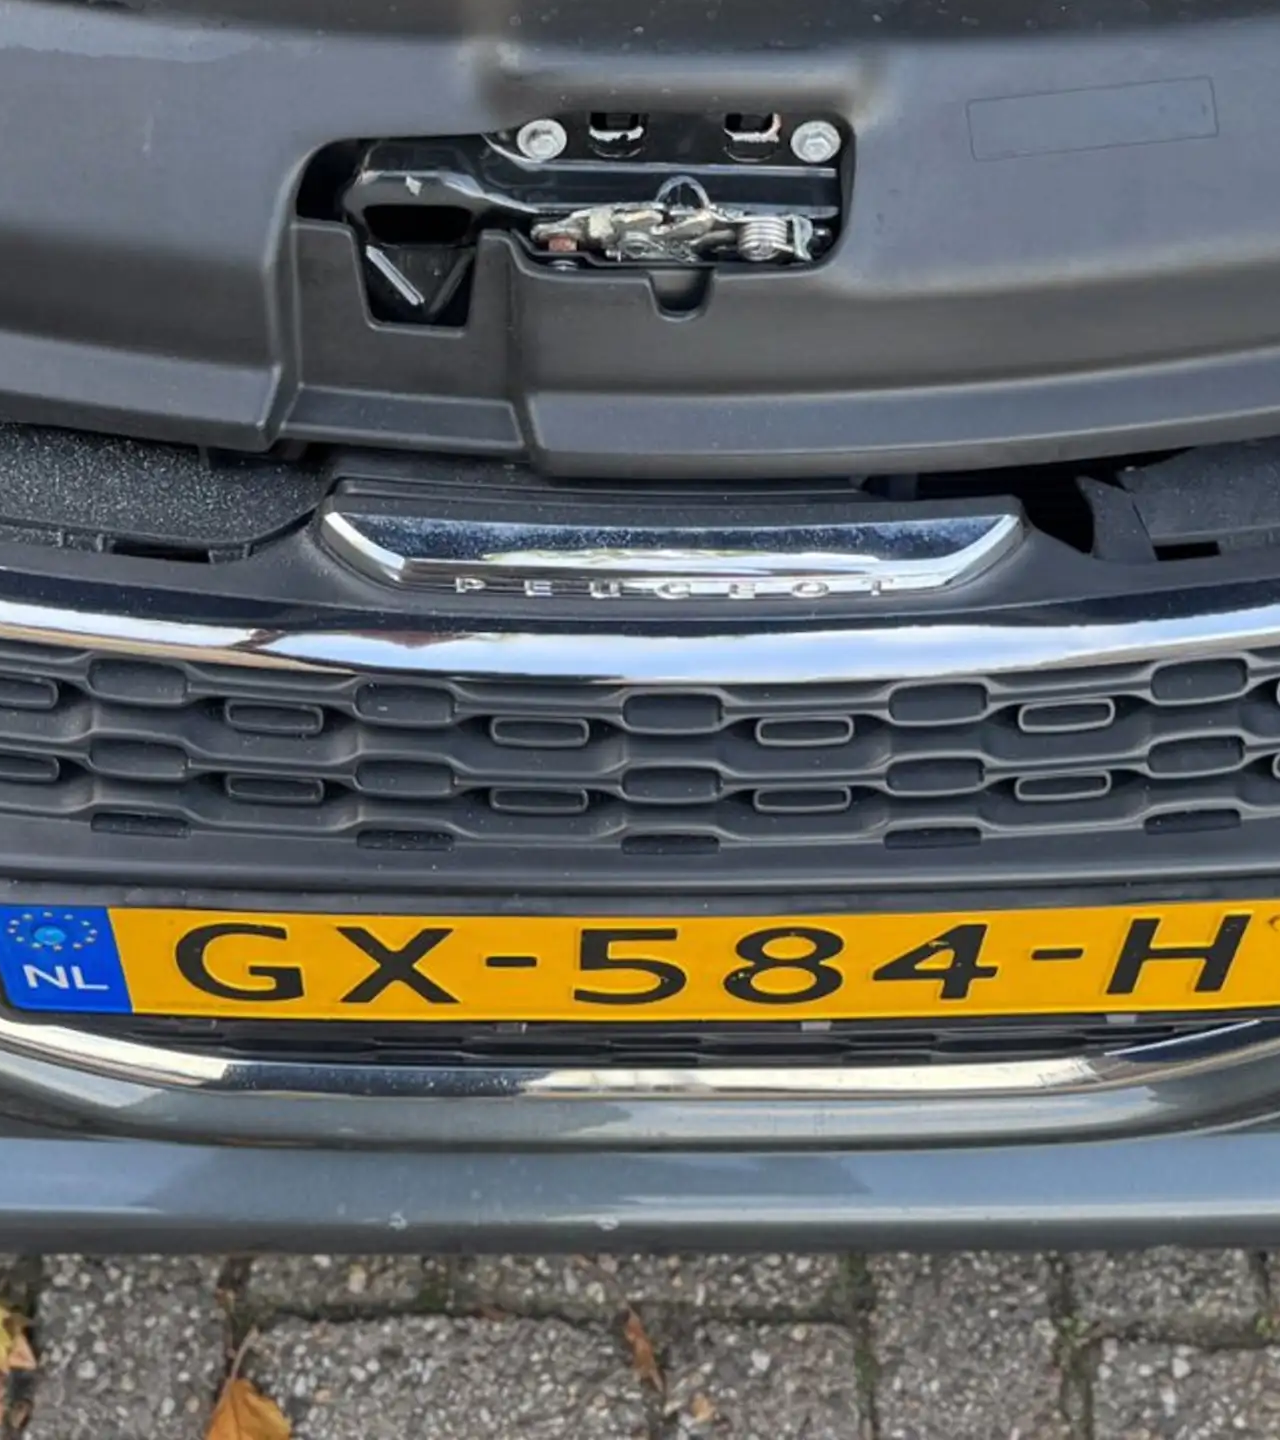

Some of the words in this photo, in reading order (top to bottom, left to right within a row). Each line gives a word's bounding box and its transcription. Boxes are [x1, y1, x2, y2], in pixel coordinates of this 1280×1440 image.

[455, 577, 895, 599] PEUGEOT
[175, 913, 1253, 1005] GX-584-H
[22, 964, 110, 990] NL
